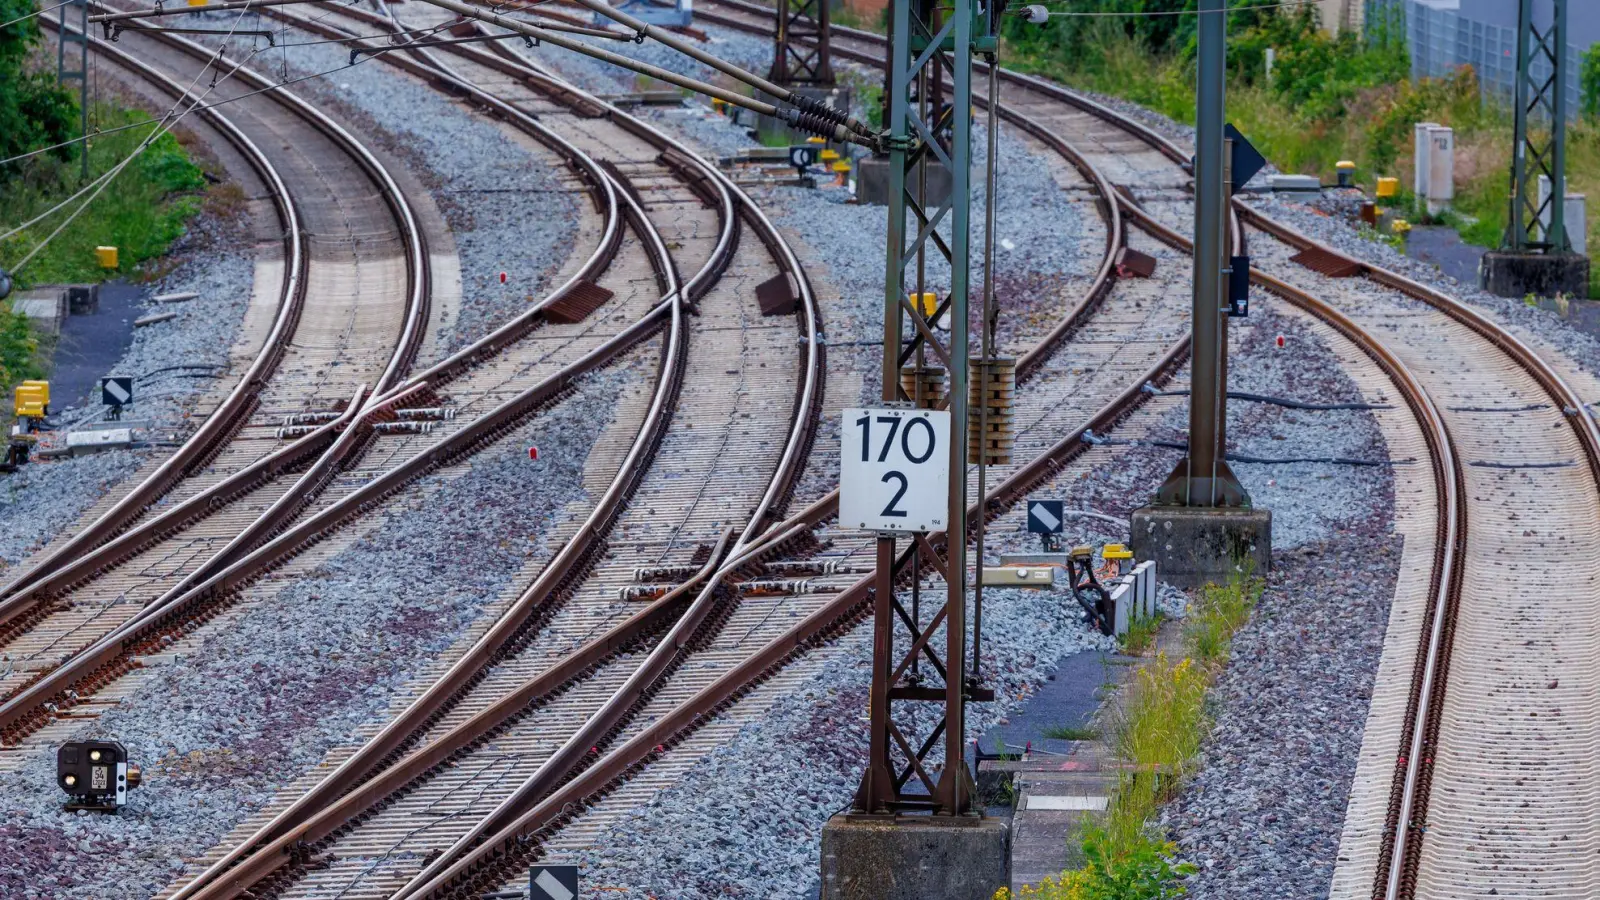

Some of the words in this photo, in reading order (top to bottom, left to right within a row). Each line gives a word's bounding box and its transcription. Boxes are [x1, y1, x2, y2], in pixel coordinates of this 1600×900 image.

[856, 415, 936, 464] 170
[879, 470, 908, 517] 2
[95, 770, 104, 779] 54
